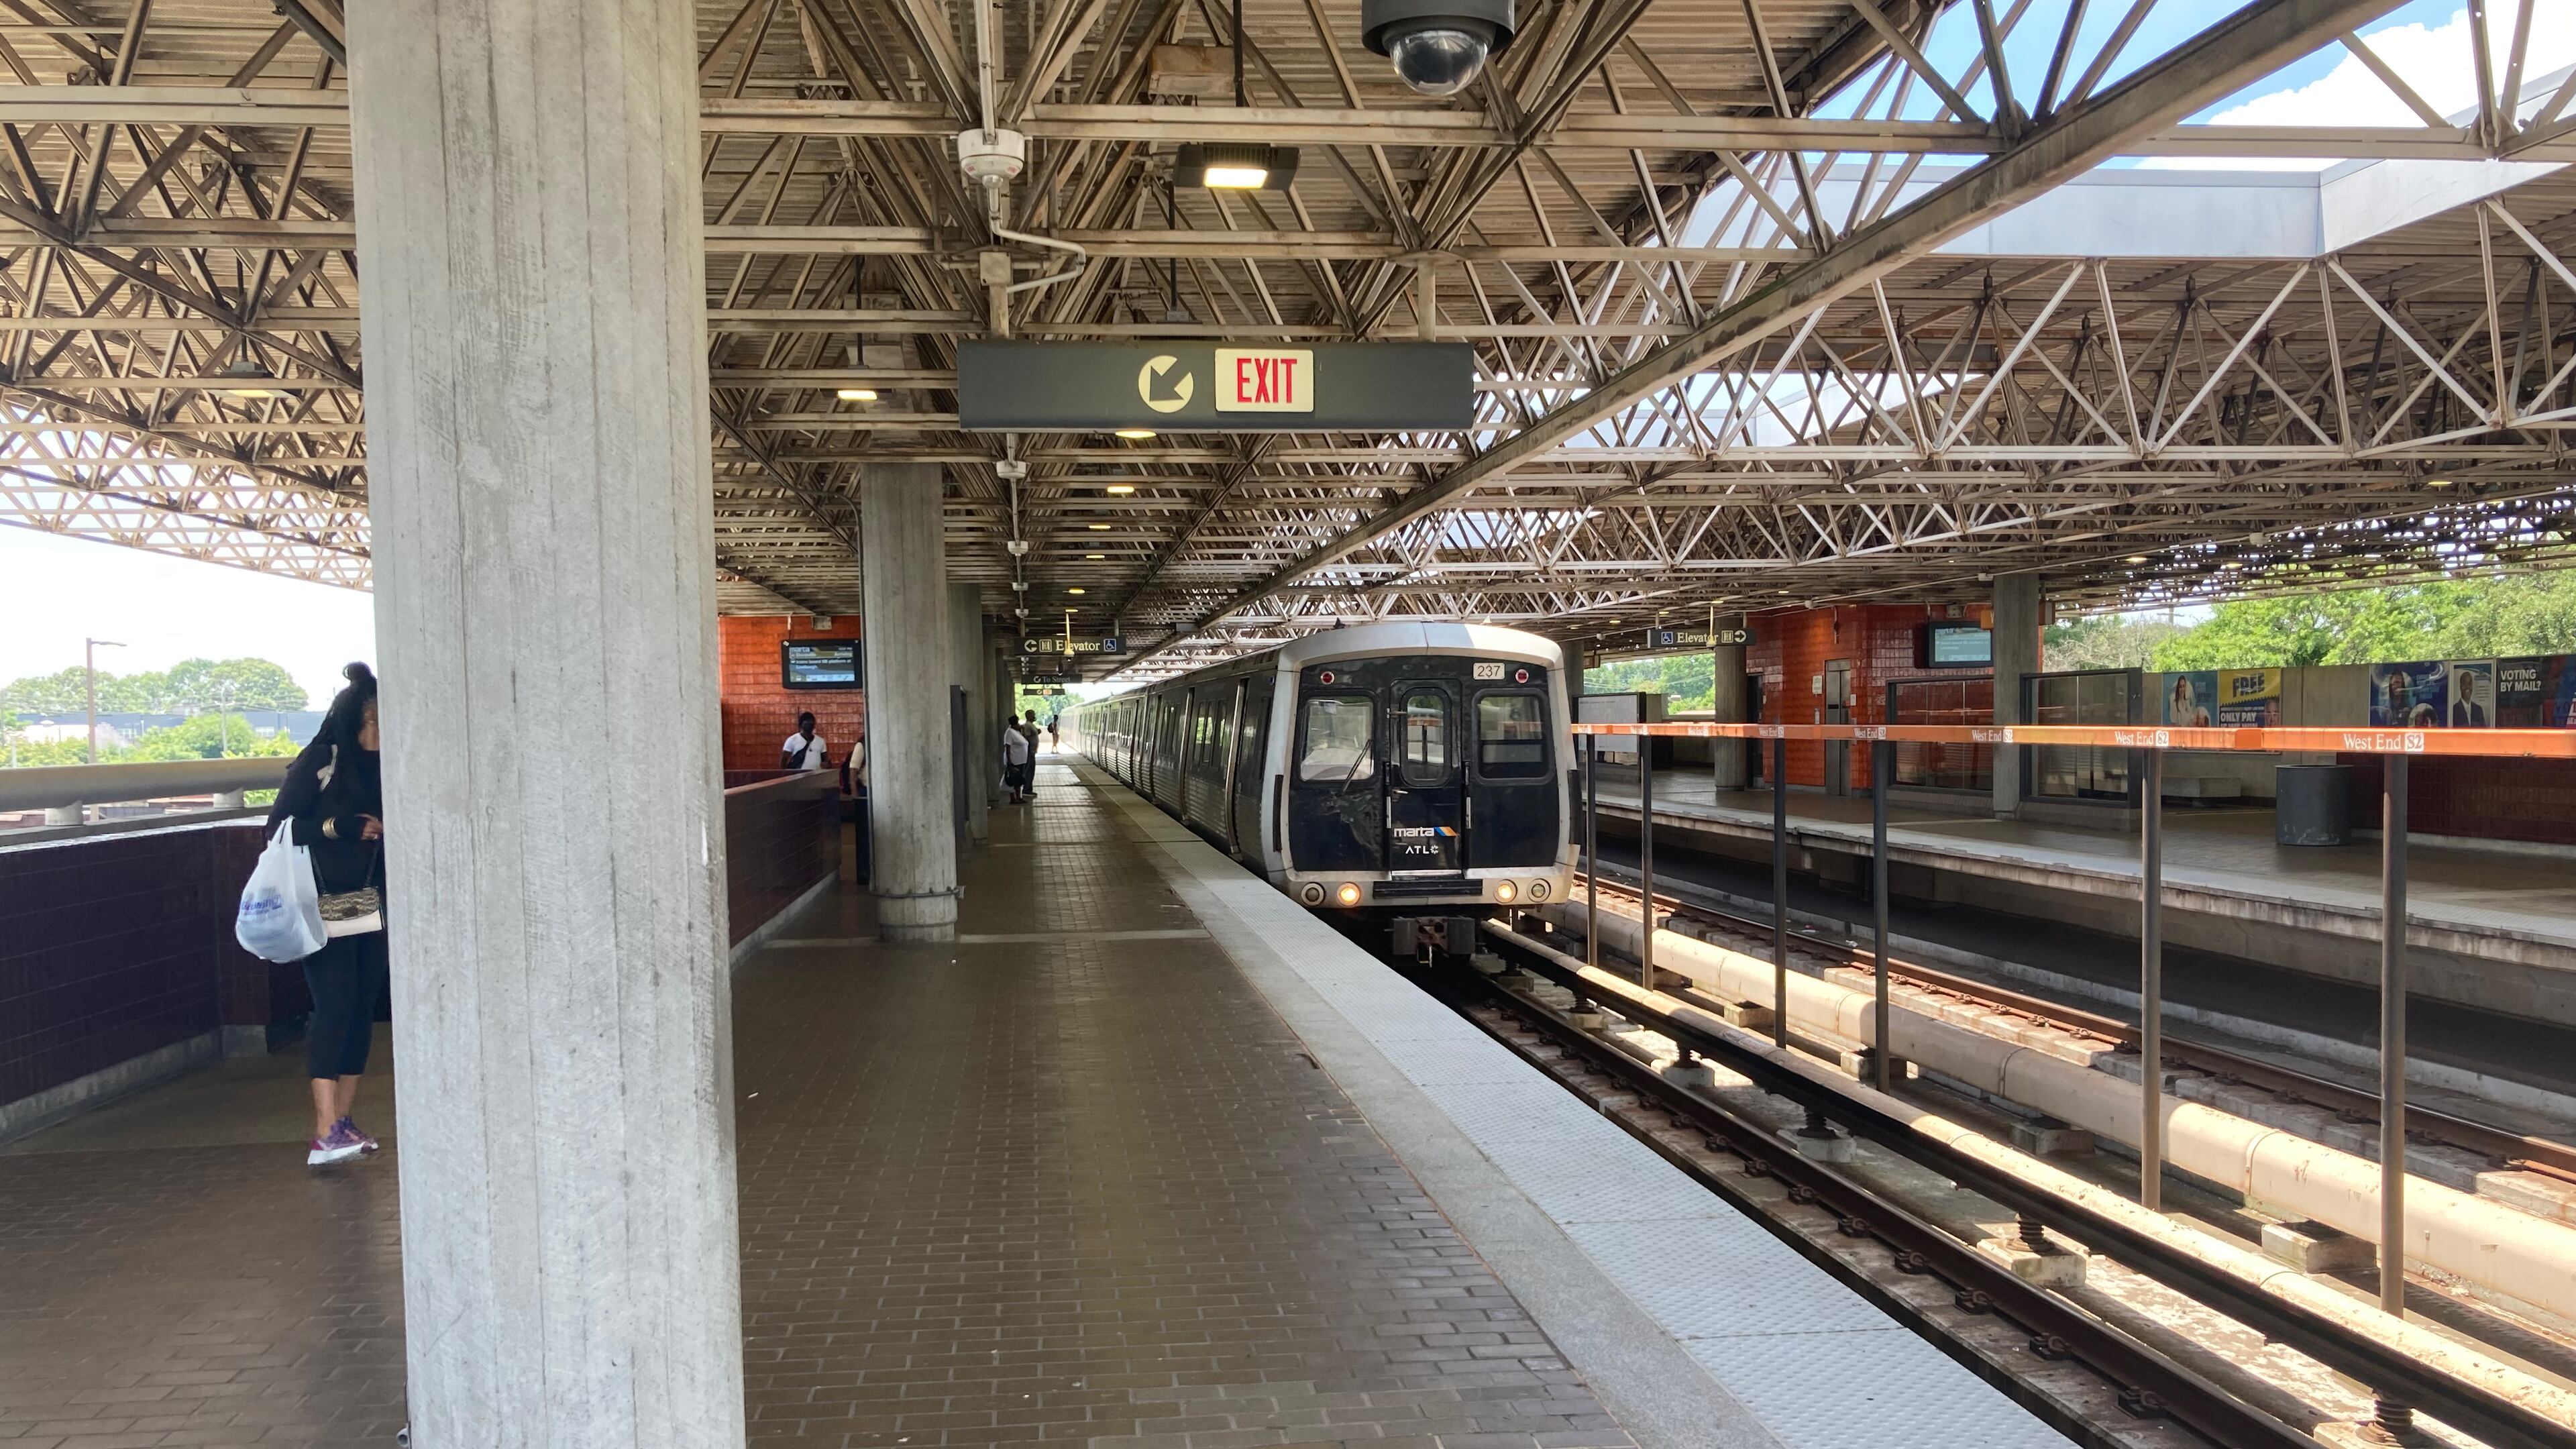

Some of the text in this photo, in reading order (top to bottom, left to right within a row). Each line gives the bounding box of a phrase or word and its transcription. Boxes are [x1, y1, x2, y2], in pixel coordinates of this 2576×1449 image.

[1237, 358, 1297, 403] EXIT
[1676, 632, 1719, 643] Elevator
[1055, 640, 1100, 651] Elevator
[1477, 665, 1500, 677] 237
[2500, 669, 2536, 680] VOTING
[2232, 673, 2265, 698] FREE
[2500, 680, 2541, 692] BY MAIL?
[2220, 711, 2257, 722] ONLY PAY
[1854, 728, 1866, 738] West
[1867, 728, 1878, 738] End
[1972, 729, 2012, 742] West End S2
[2114, 731, 2168, 745] West End S2
[2343, 733, 2423, 750] West End S2
[1394, 826, 1434, 837] marta
